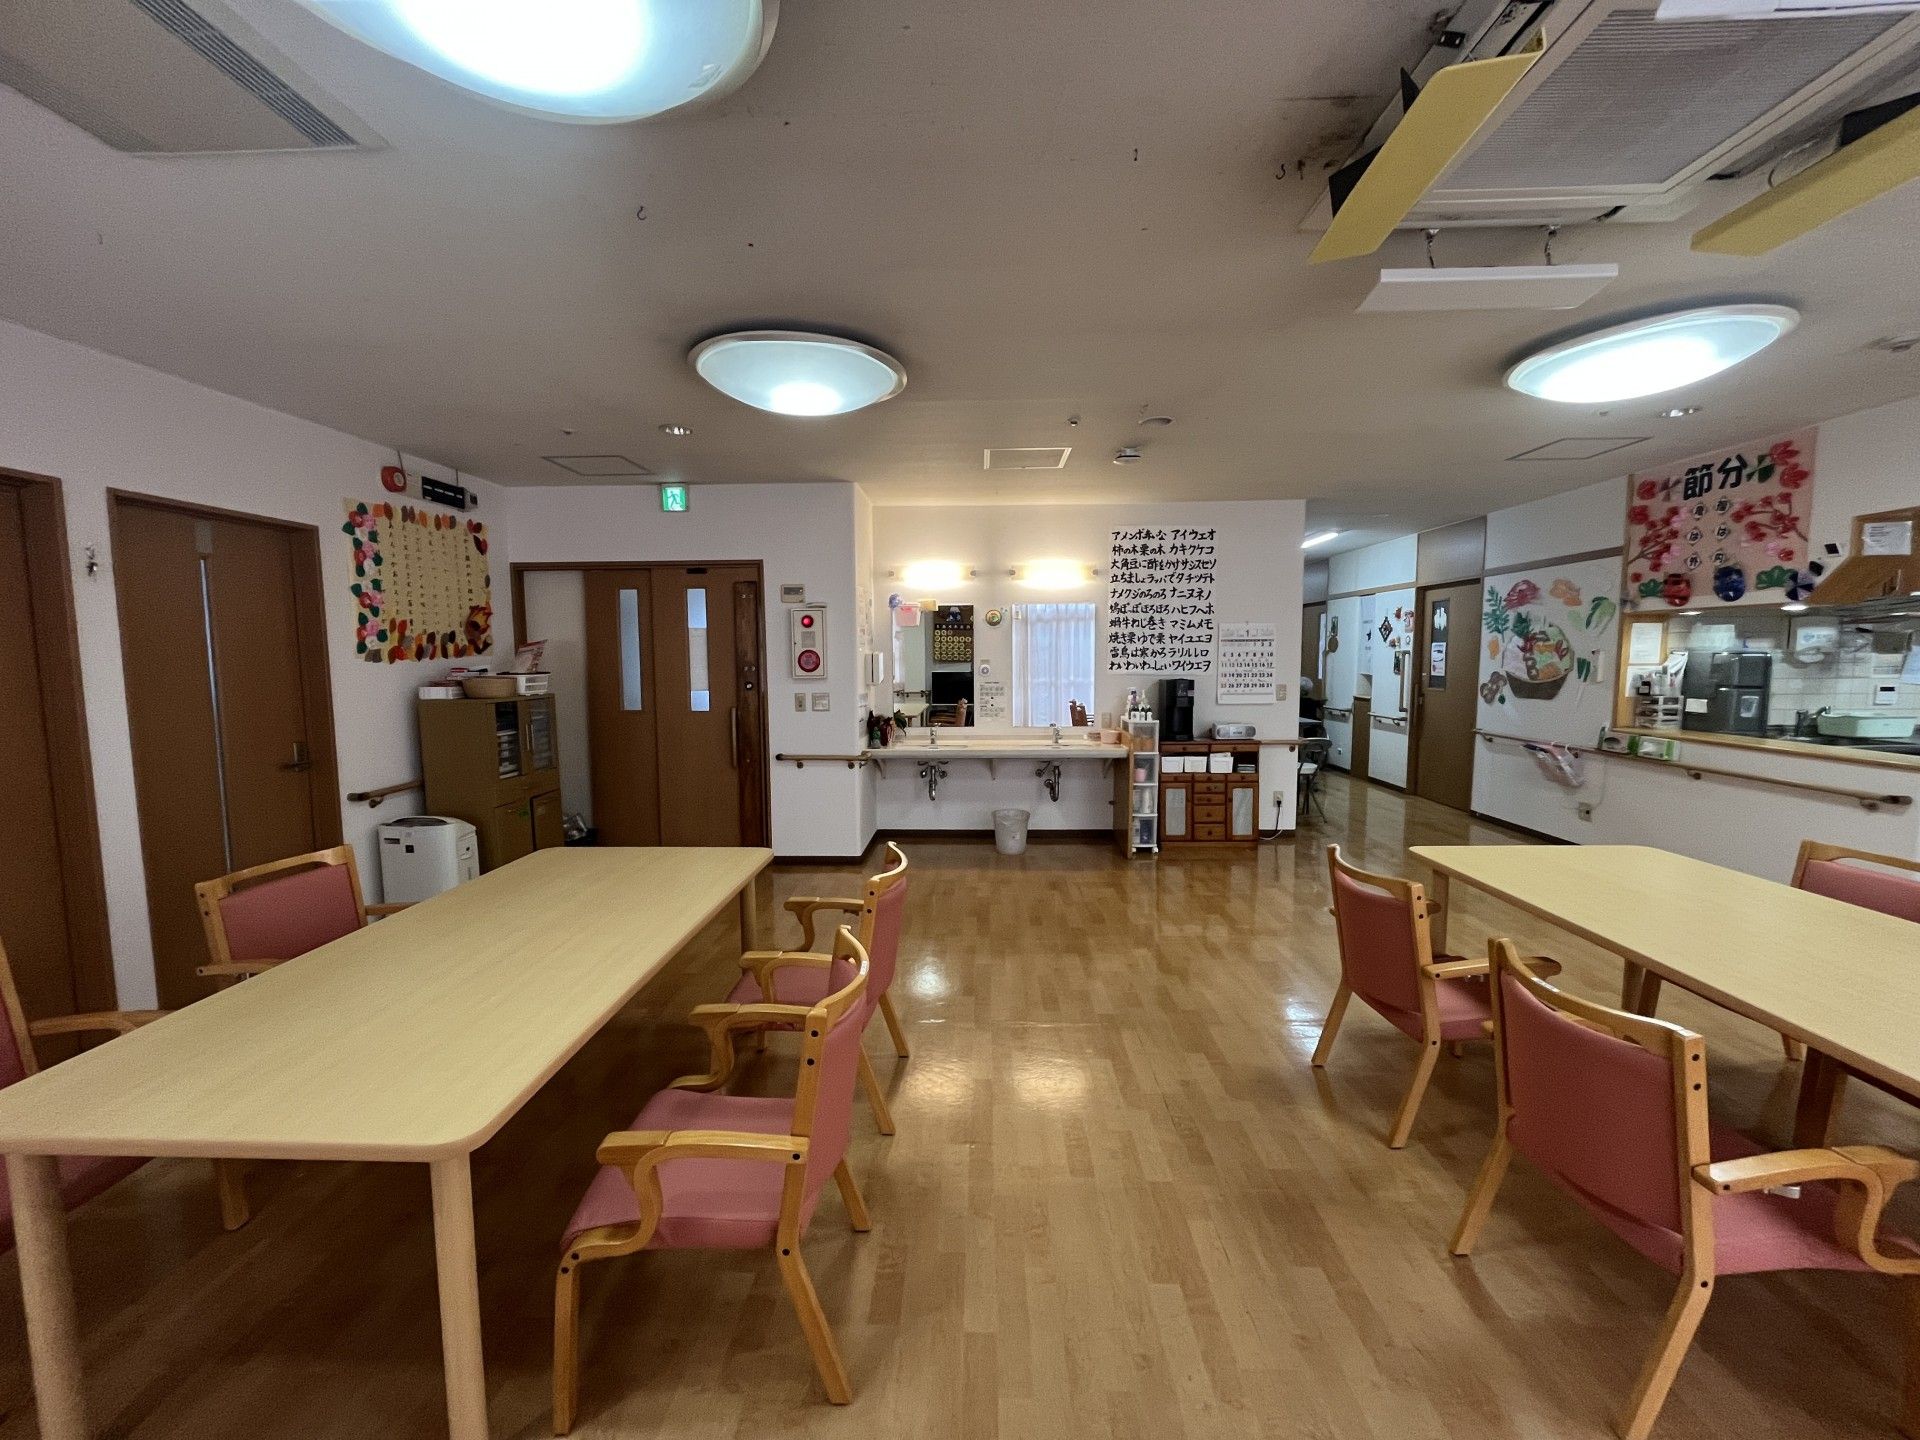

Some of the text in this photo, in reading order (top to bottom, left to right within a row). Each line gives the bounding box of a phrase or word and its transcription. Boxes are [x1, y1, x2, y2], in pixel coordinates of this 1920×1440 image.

[1683, 454, 1748, 501] 節分
[1169, 543, 1214, 555] カキクケコ
[1170, 587, 1212, 600] ナニヌネノ
[1170, 619, 1214, 630] マミムメモ
[1169, 634, 1213, 644] ヤイユエヨ
